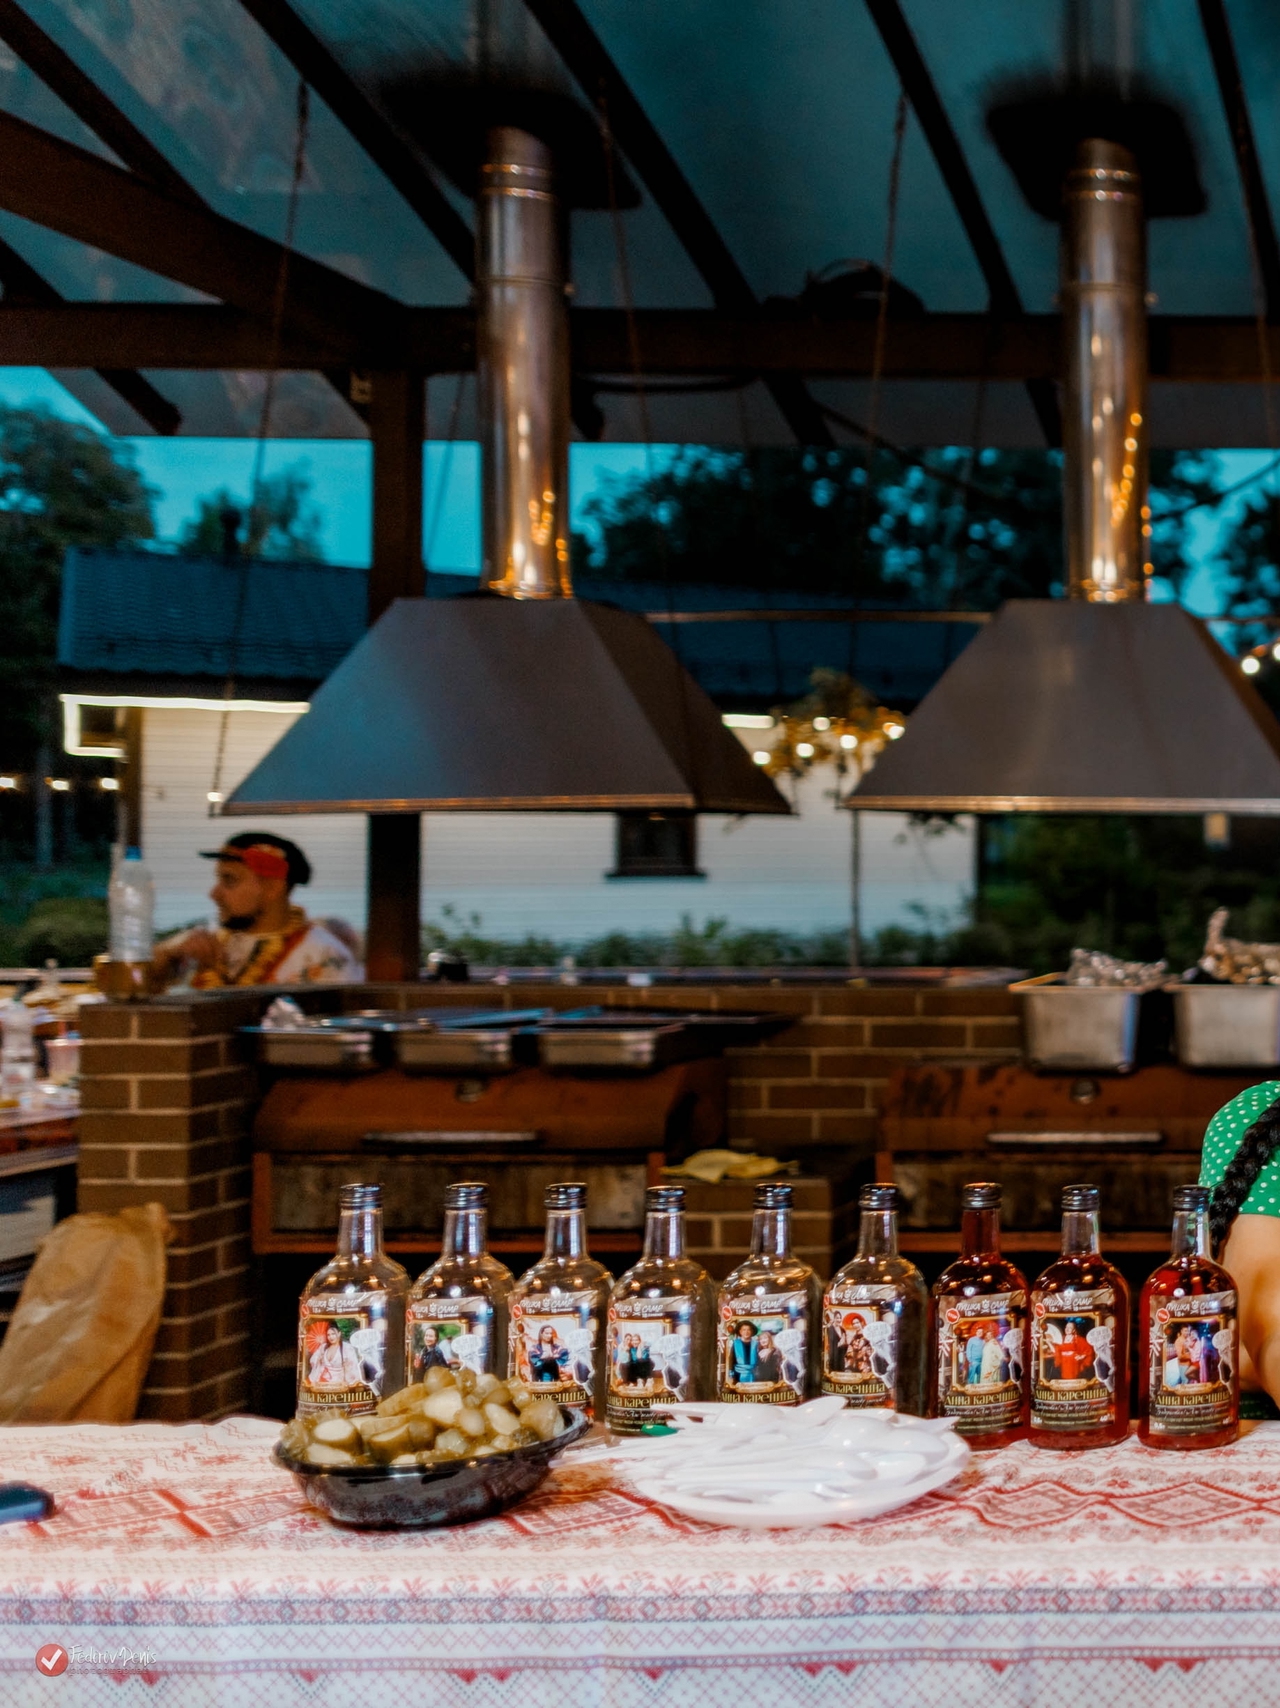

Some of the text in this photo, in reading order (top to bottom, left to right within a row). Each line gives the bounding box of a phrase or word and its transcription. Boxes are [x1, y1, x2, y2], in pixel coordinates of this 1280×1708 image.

[1072, 1297, 1093, 1306] CAMP
[437, 1305, 459, 1313] CAMP
[642, 1304, 664, 1312] CAMP
